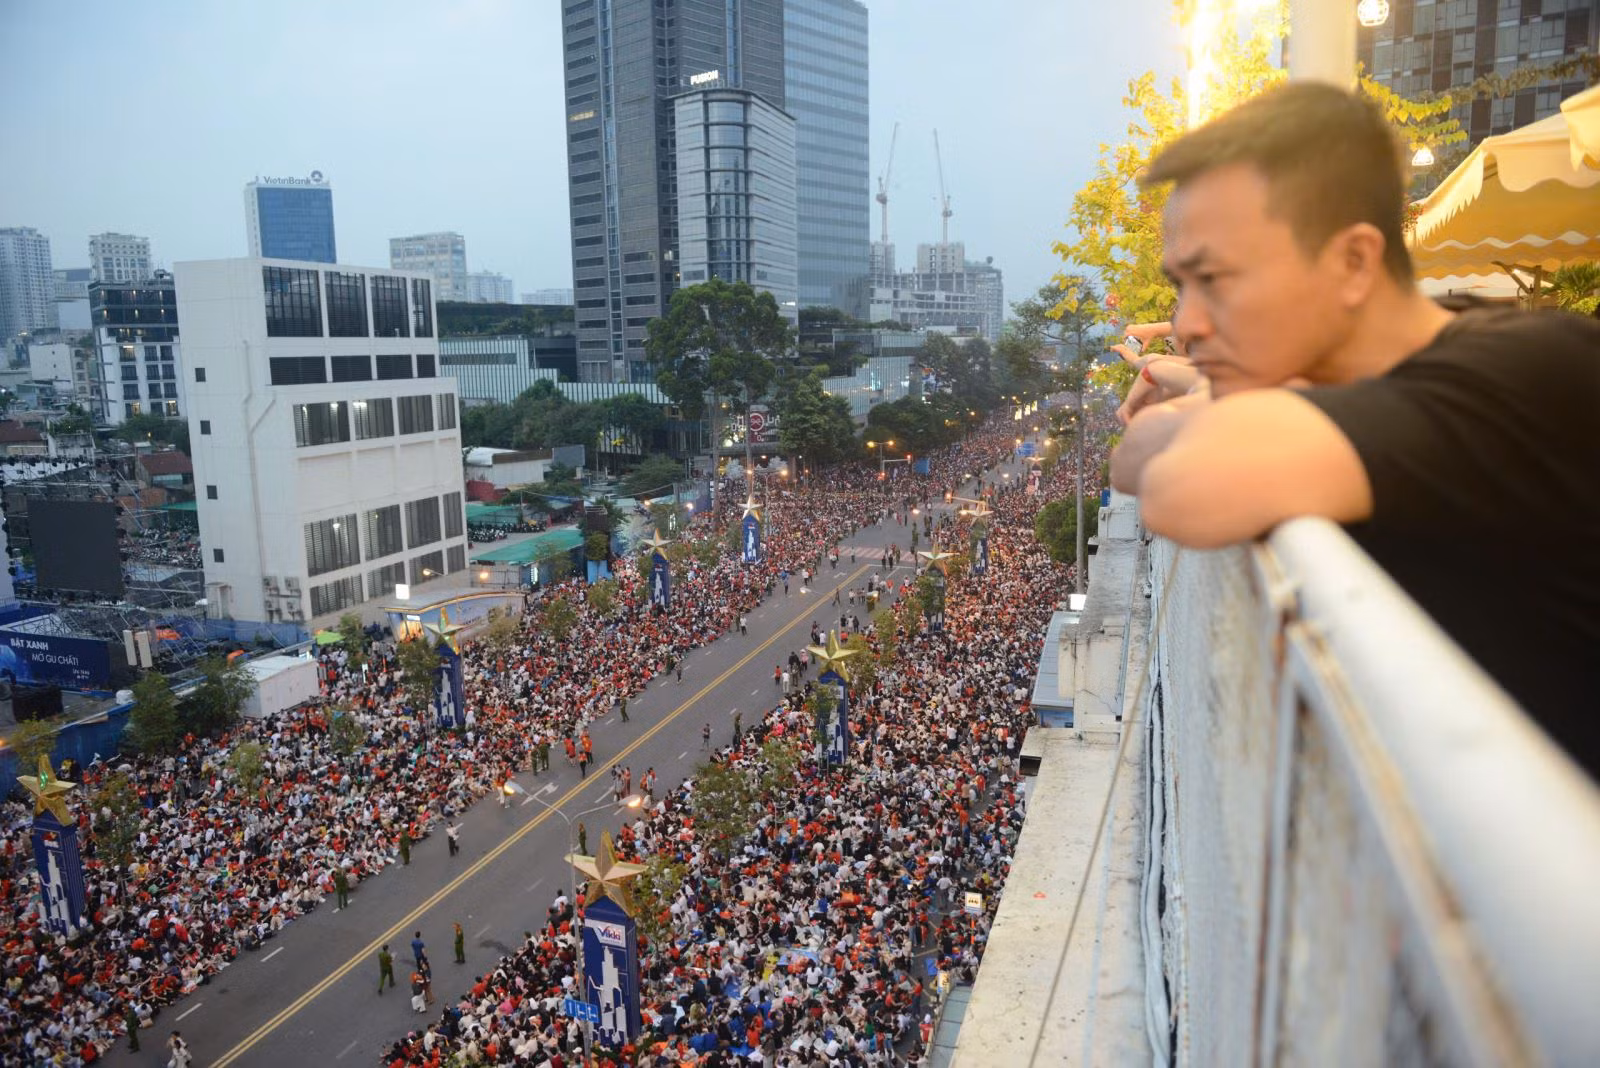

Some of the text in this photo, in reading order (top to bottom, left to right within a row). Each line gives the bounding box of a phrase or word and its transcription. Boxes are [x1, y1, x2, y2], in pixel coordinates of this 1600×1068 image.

[263, 175, 311, 185] VietinBank
[26, 640, 49, 651] XANH
[45, 654, 57, 664] GU
